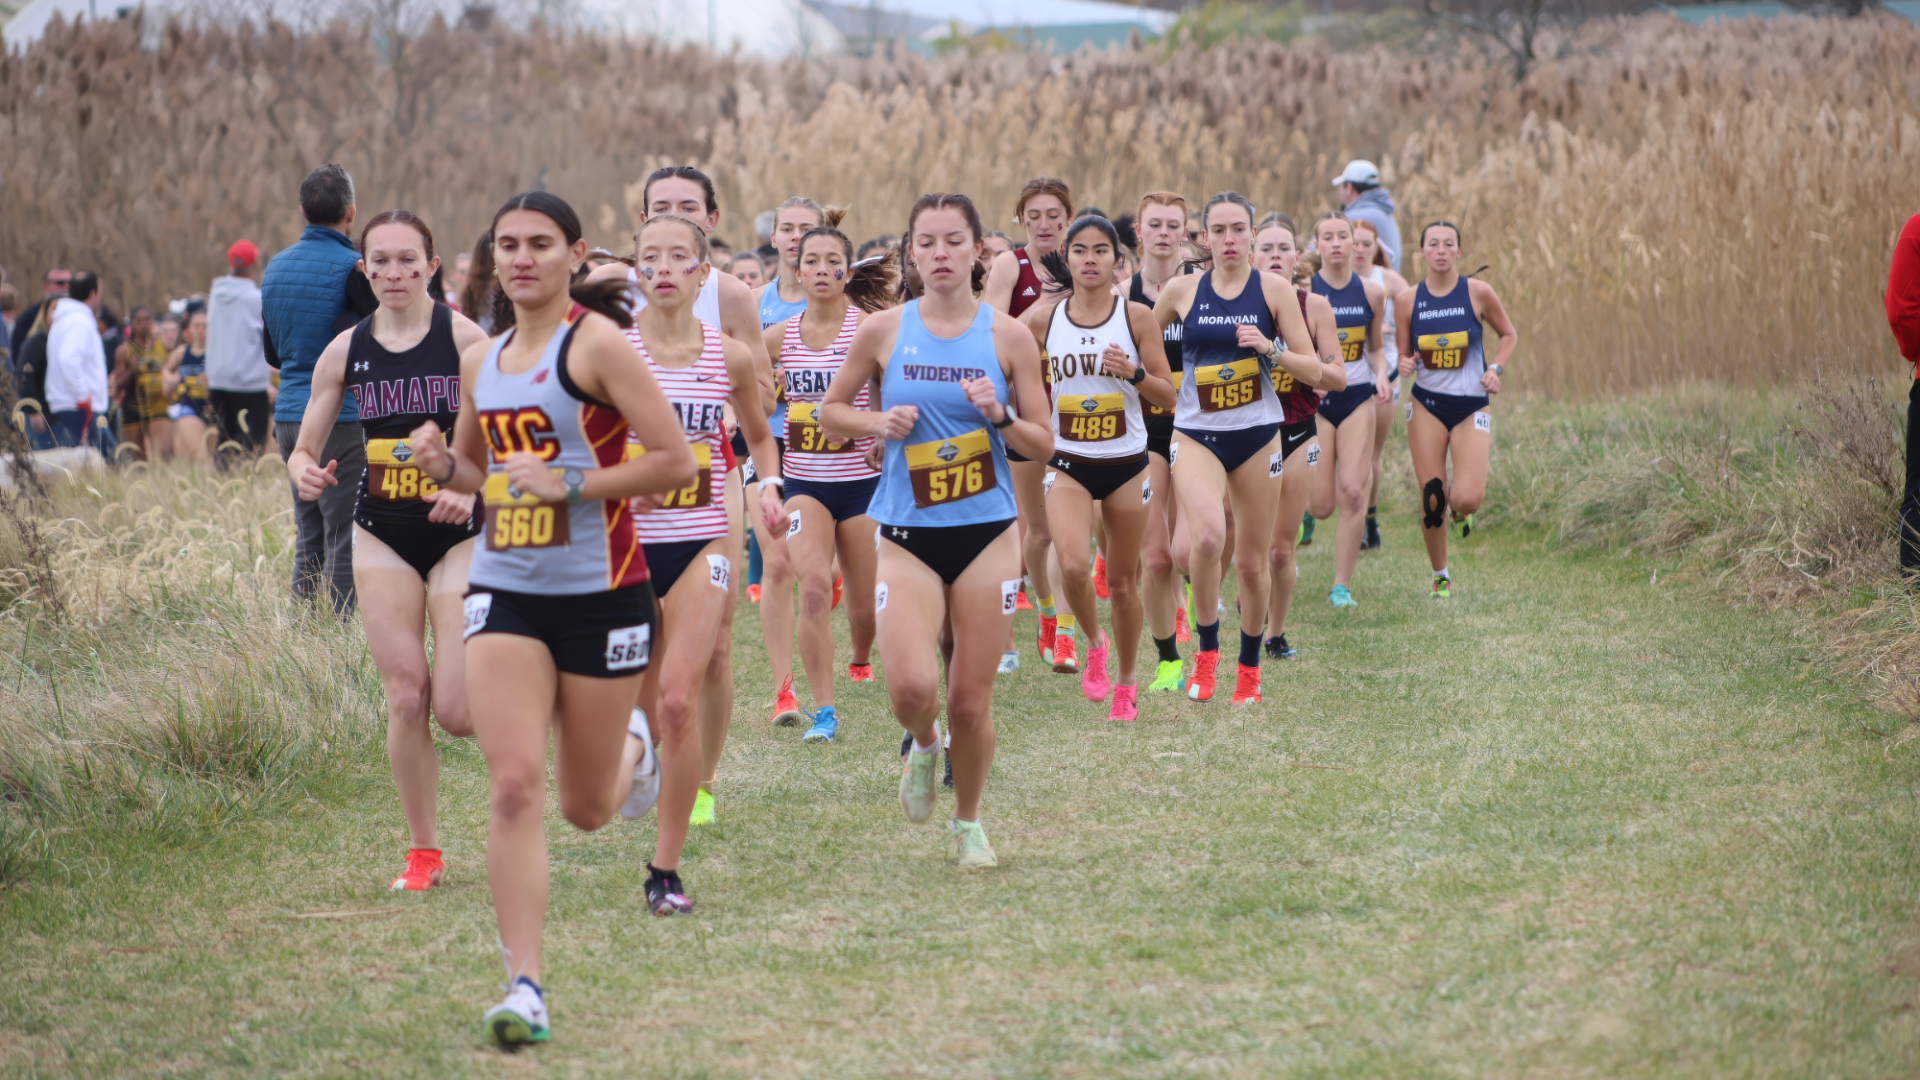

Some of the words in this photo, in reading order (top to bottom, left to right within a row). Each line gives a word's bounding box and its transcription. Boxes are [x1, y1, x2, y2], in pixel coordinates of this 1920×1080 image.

[1198, 314, 1258, 325] MORAVIAN
[1419, 306, 1466, 321] MORAVIAN
[1432, 349, 1461, 368] 451
[1211, 379, 1254, 409] 455
[1071, 415, 1117, 439] 489
[929, 460, 983, 502] 576
[494, 506, 555, 547] 560
